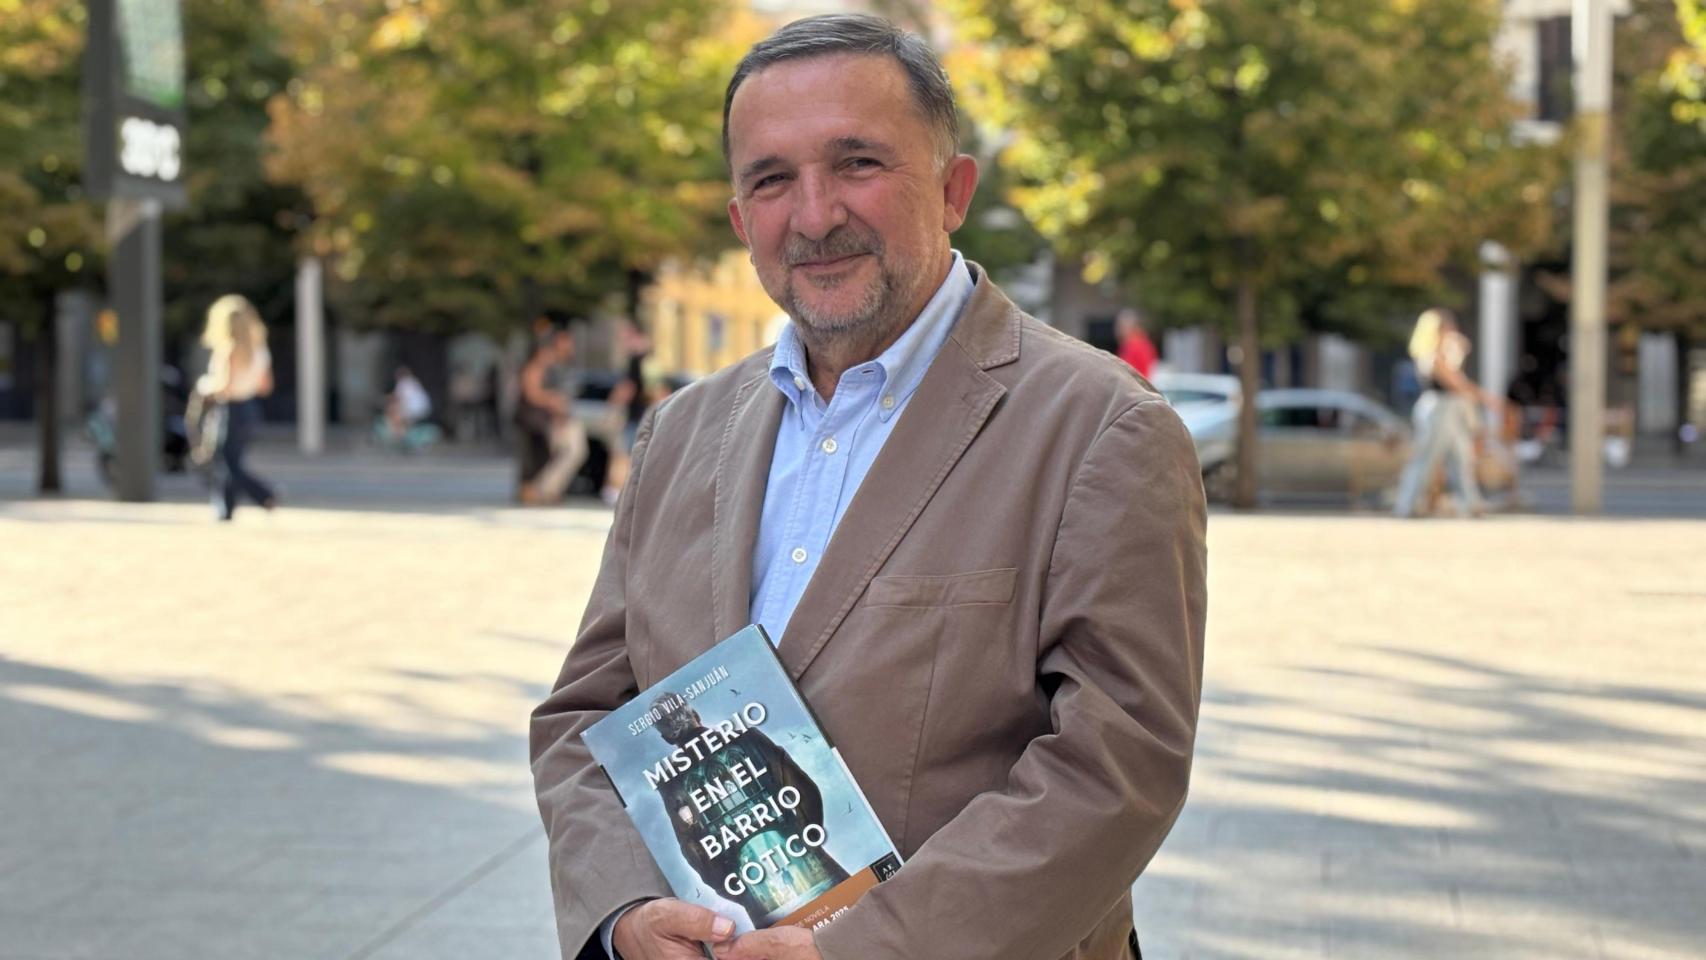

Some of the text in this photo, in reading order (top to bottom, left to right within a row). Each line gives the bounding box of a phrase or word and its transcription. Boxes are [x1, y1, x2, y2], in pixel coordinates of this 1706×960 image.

[628, 665, 729, 736] SERGIO VILA-SANJUÁN
[642, 702, 766, 791] MISTERIO
[689, 757, 767, 814] EN EL
[700, 786, 800, 860] BARRIO
[724, 823, 826, 896] GÓTICO
[812, 917, 831, 932] ARA
